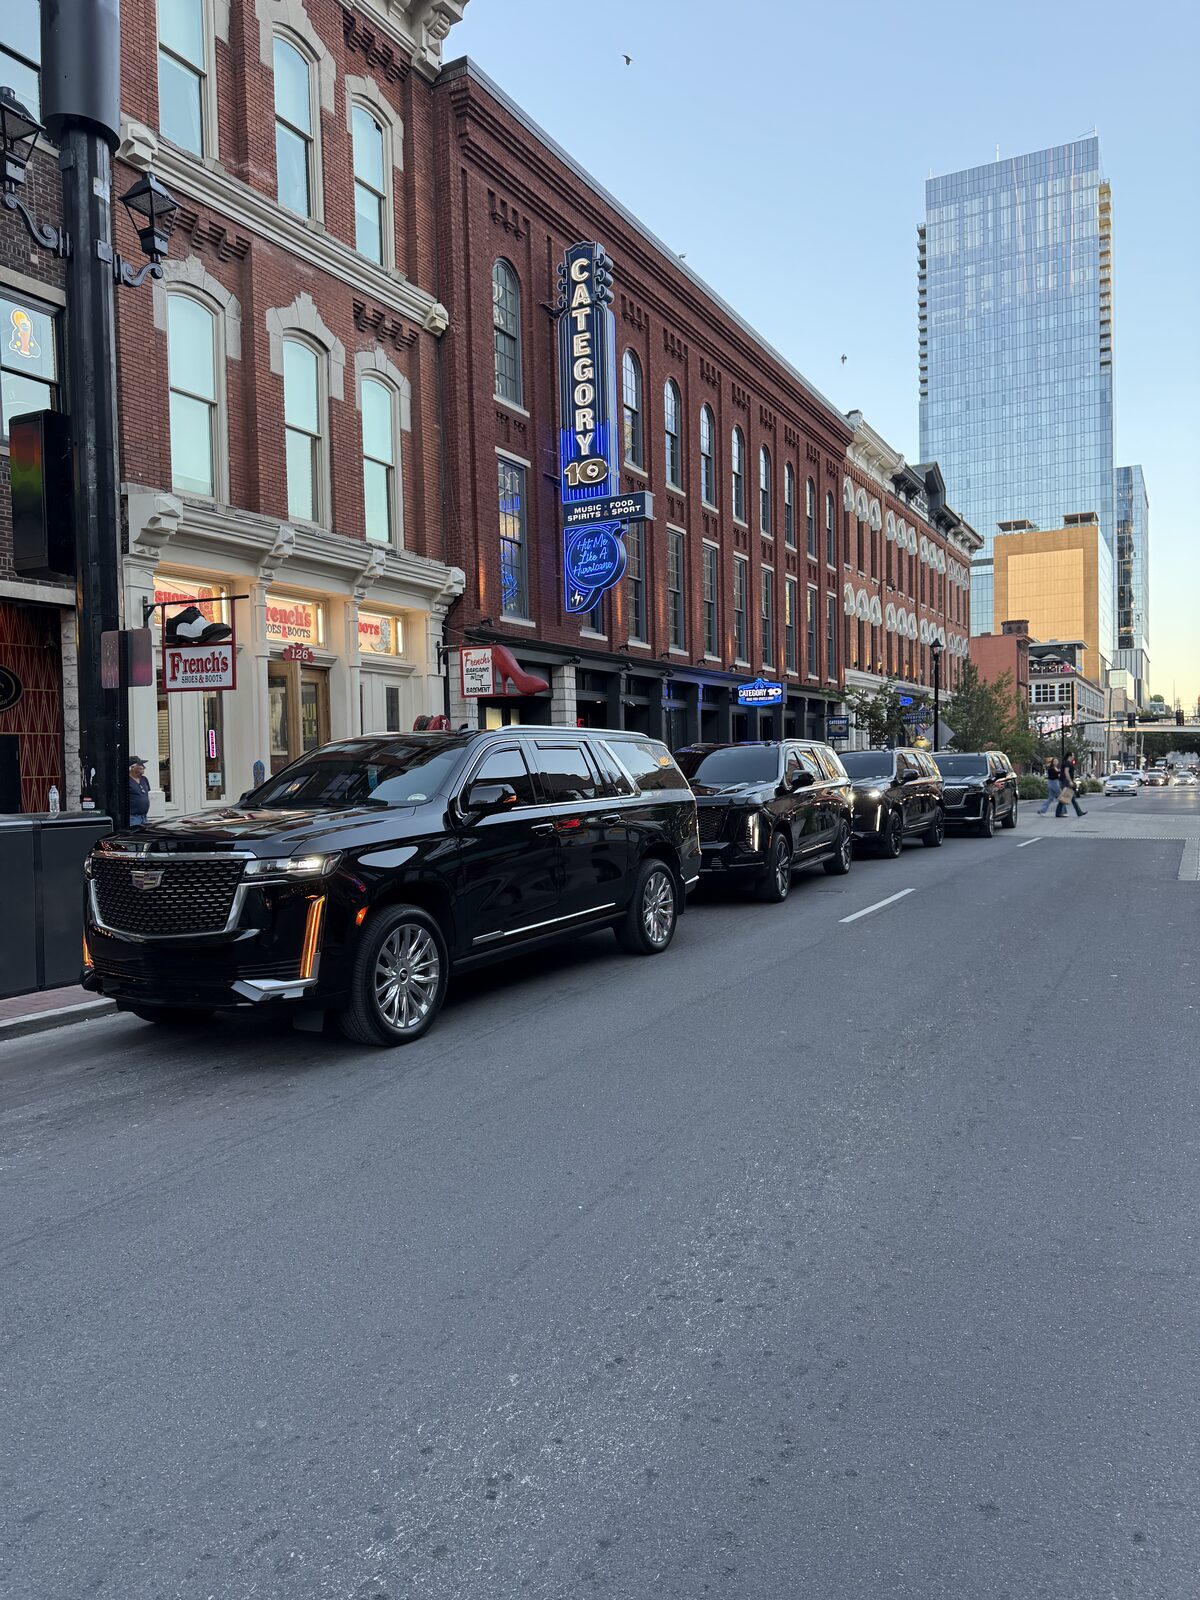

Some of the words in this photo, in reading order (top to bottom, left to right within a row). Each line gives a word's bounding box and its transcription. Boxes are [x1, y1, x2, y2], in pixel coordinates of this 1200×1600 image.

[570, 257, 595, 456] CATEGORY
[564, 458, 609, 486] 10
[567, 510, 601, 522] SPIRITS
[611, 505, 642, 515] SPORT
[573, 504, 602, 514] MUSIC
[609, 499, 634, 509] FOOD
[577, 537, 594, 552] Hit
[592, 533, 609, 548] Me
[577, 550, 598, 565] Like
[599, 546, 608, 560] A
[573, 561, 614, 577] Hurricane
[265, 605, 312, 628] rench's
[265, 623, 282, 634] OES
[281, 625, 289, 638] &
[287, 626, 311, 638] BOOTS
[358, 622, 380, 636] OOTS
[290, 649, 309, 660] 126
[168, 650, 229, 682] French's
[181, 675, 199, 684] SHOES
[198, 675, 205, 684] &
[204, 674, 223, 683] BOOTS
[738, 689, 767, 697] CATEGORY
[767, 687, 782, 696] 10
